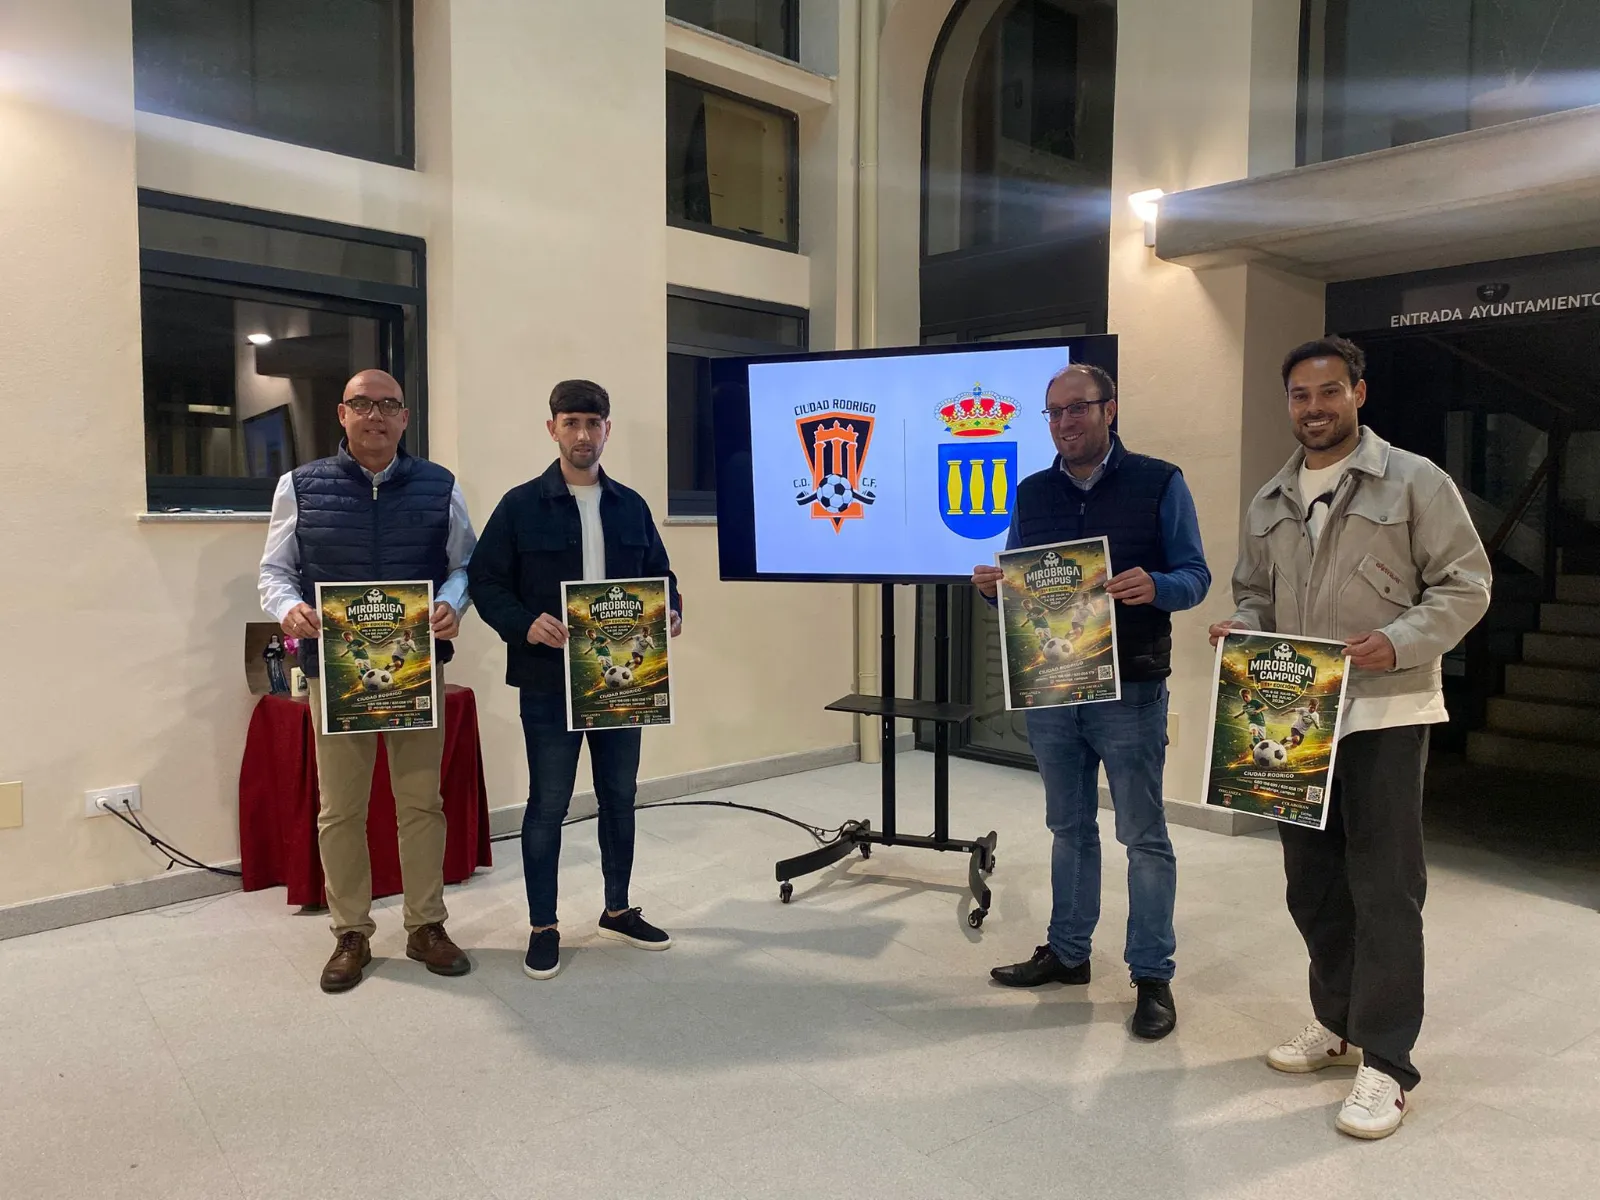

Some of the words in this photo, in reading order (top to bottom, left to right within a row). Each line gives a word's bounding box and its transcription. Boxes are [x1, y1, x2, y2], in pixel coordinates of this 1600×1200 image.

[1390, 308, 1462, 328] ENTRADA
[794, 399, 830, 416] CIUDAD
[832, 398, 877, 414] RODRIGO
[862, 477, 877, 488] C.F.
[1026, 565, 1080, 583] MIROBRIGA
[1036, 576, 1072, 588] CAMPUS
[348, 603, 403, 616] MIROBRIGA
[591, 600, 642, 613] MIROBRIGA
[357, 612, 394, 621] CAMPUS
[600, 610, 634, 619] CAMPUS
[1250, 659, 1314, 678] MIROBRIGA
[1259, 670, 1302, 684] CAMPUS
